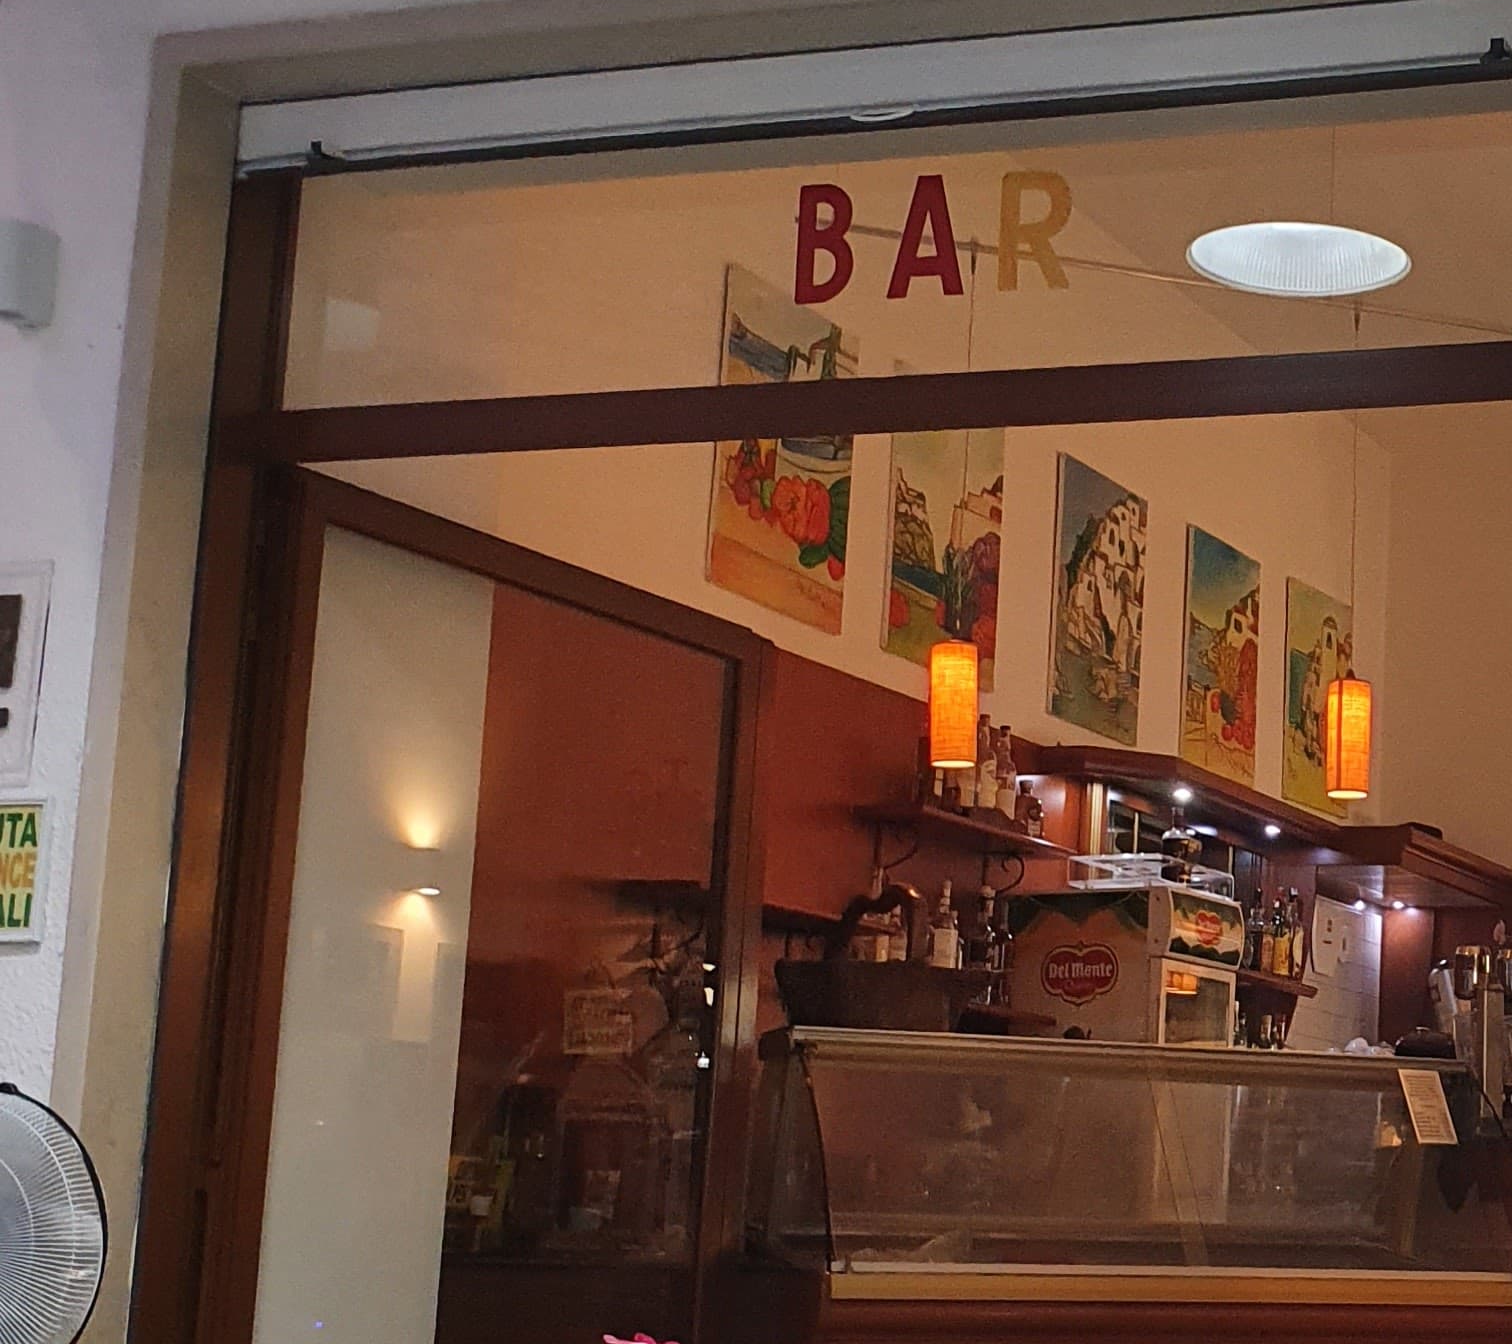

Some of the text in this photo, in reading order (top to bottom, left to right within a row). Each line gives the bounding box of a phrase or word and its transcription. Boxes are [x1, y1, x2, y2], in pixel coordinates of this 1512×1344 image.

[795, 170, 1073, 305] BAR
[1048, 961, 1113, 979] Del Monte
